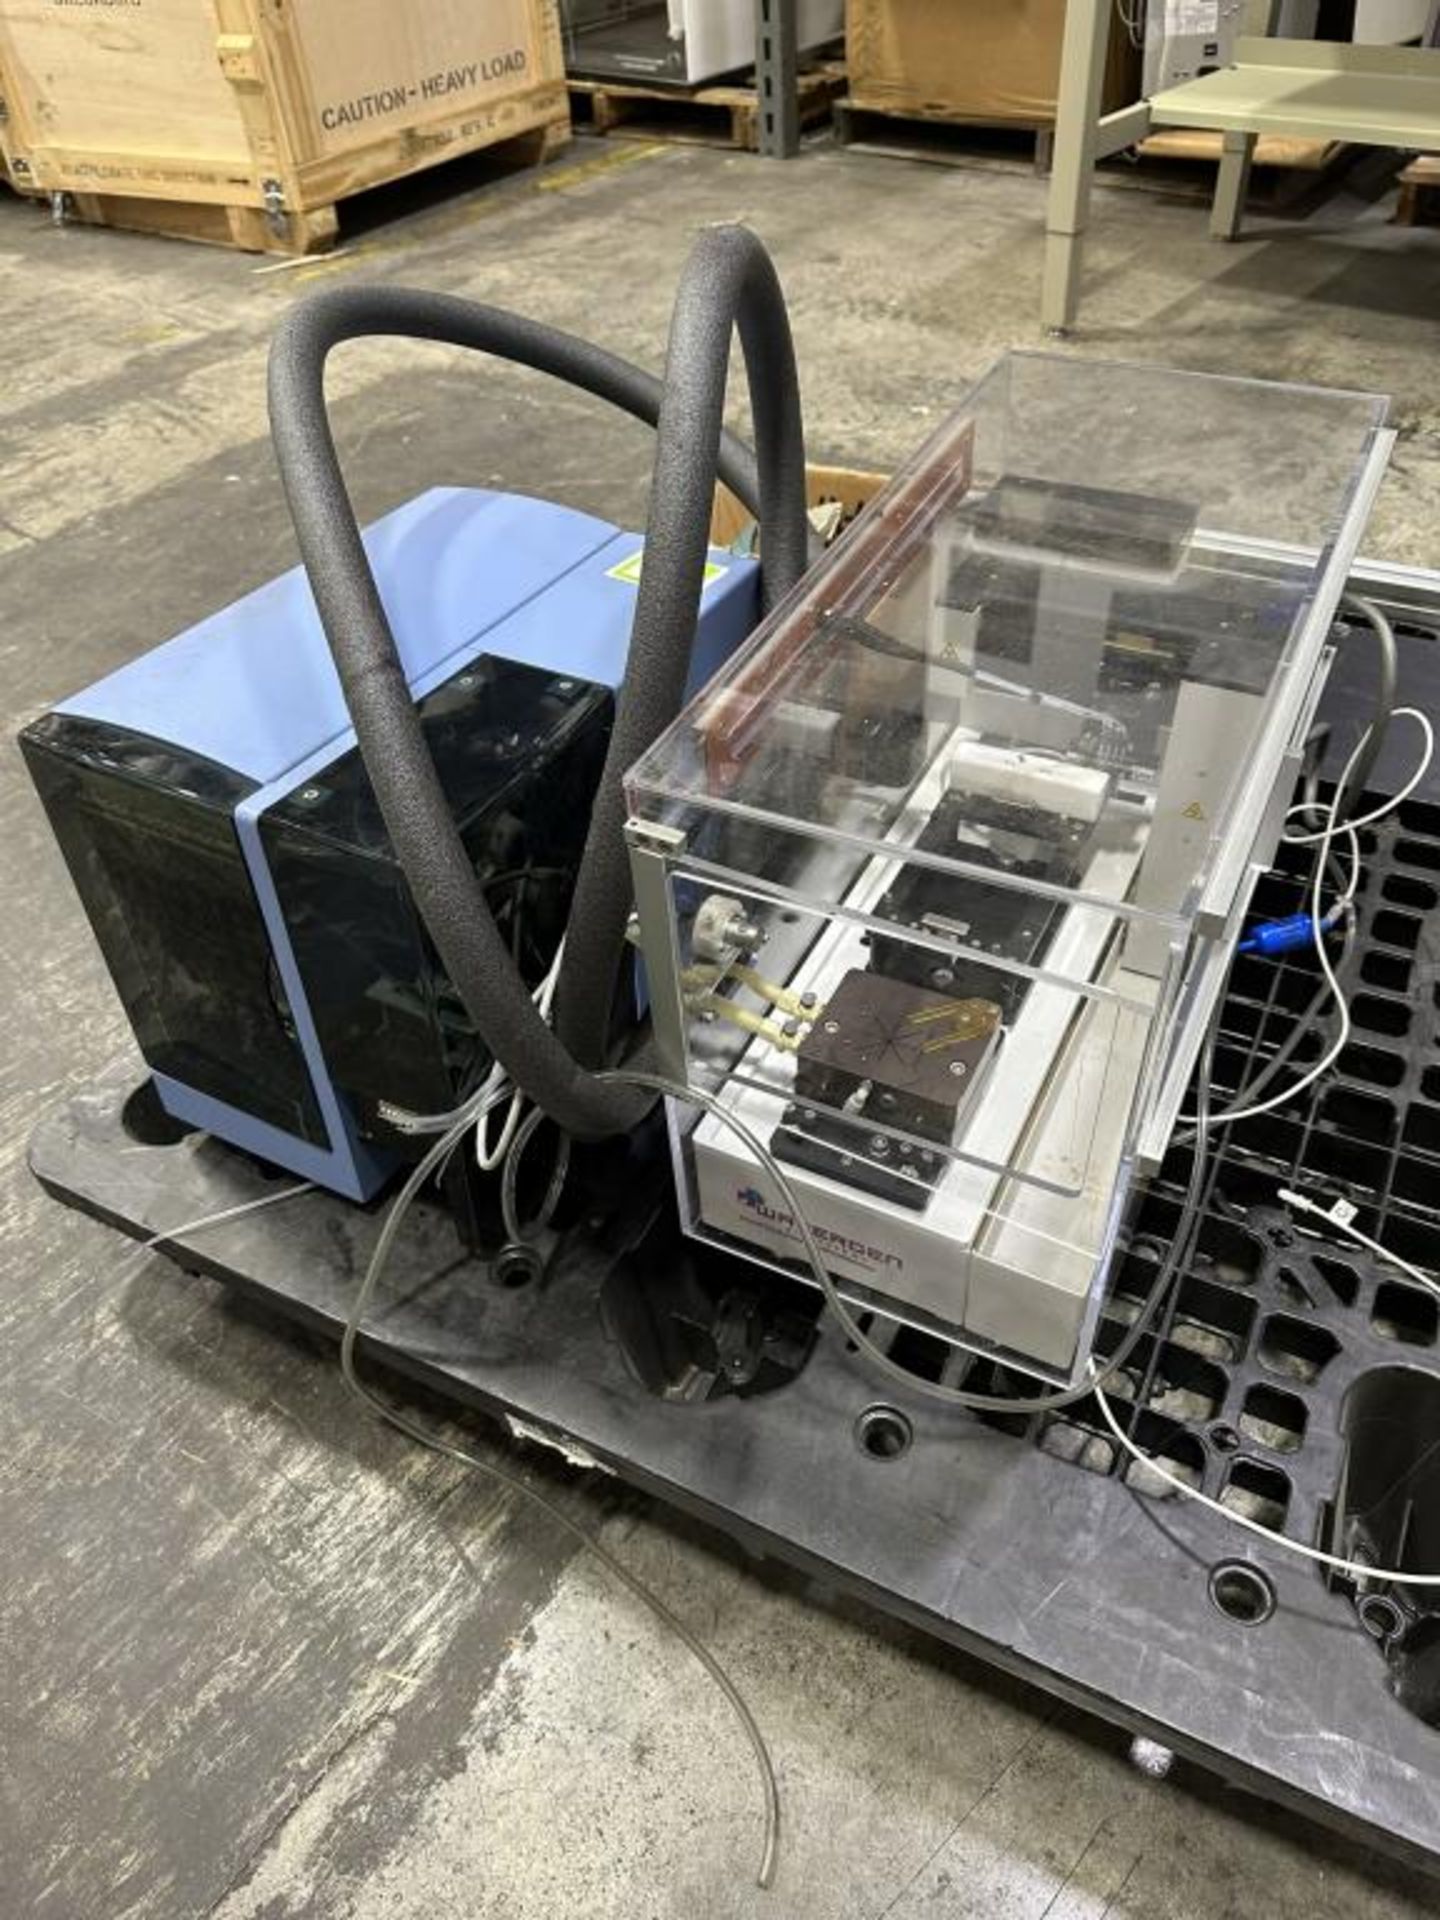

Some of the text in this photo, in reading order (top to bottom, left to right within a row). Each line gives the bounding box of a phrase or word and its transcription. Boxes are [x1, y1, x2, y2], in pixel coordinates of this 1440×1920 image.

[421, 62, 478, 99] HEAVY
[482, 49, 526, 82] LOAD
[756, 1206, 903, 1270] WAERGEN
